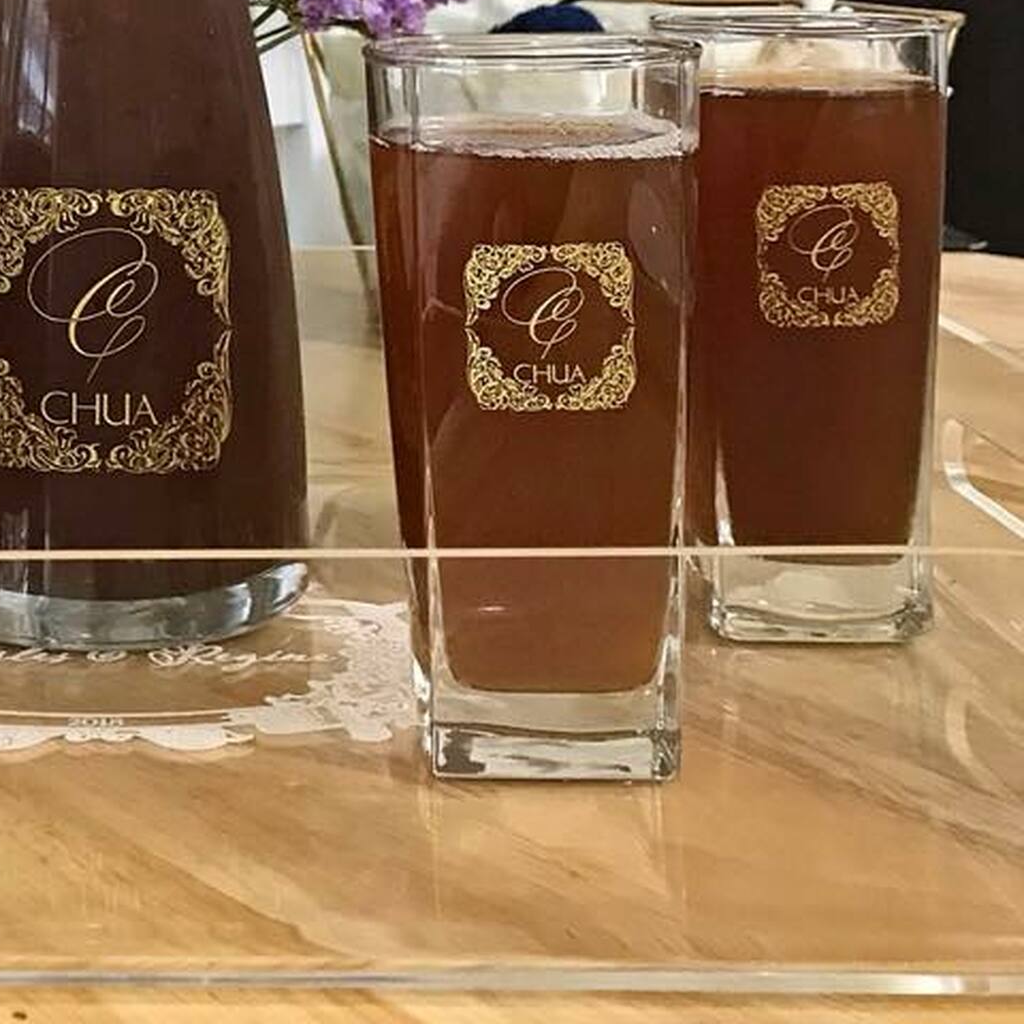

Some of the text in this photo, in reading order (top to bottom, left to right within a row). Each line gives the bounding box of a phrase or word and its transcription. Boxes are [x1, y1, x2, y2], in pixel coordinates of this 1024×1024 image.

[797, 286, 860, 304] CHUA
[513, 363, 587, 385] CHUA
[40, 390, 159, 426] CHUA
